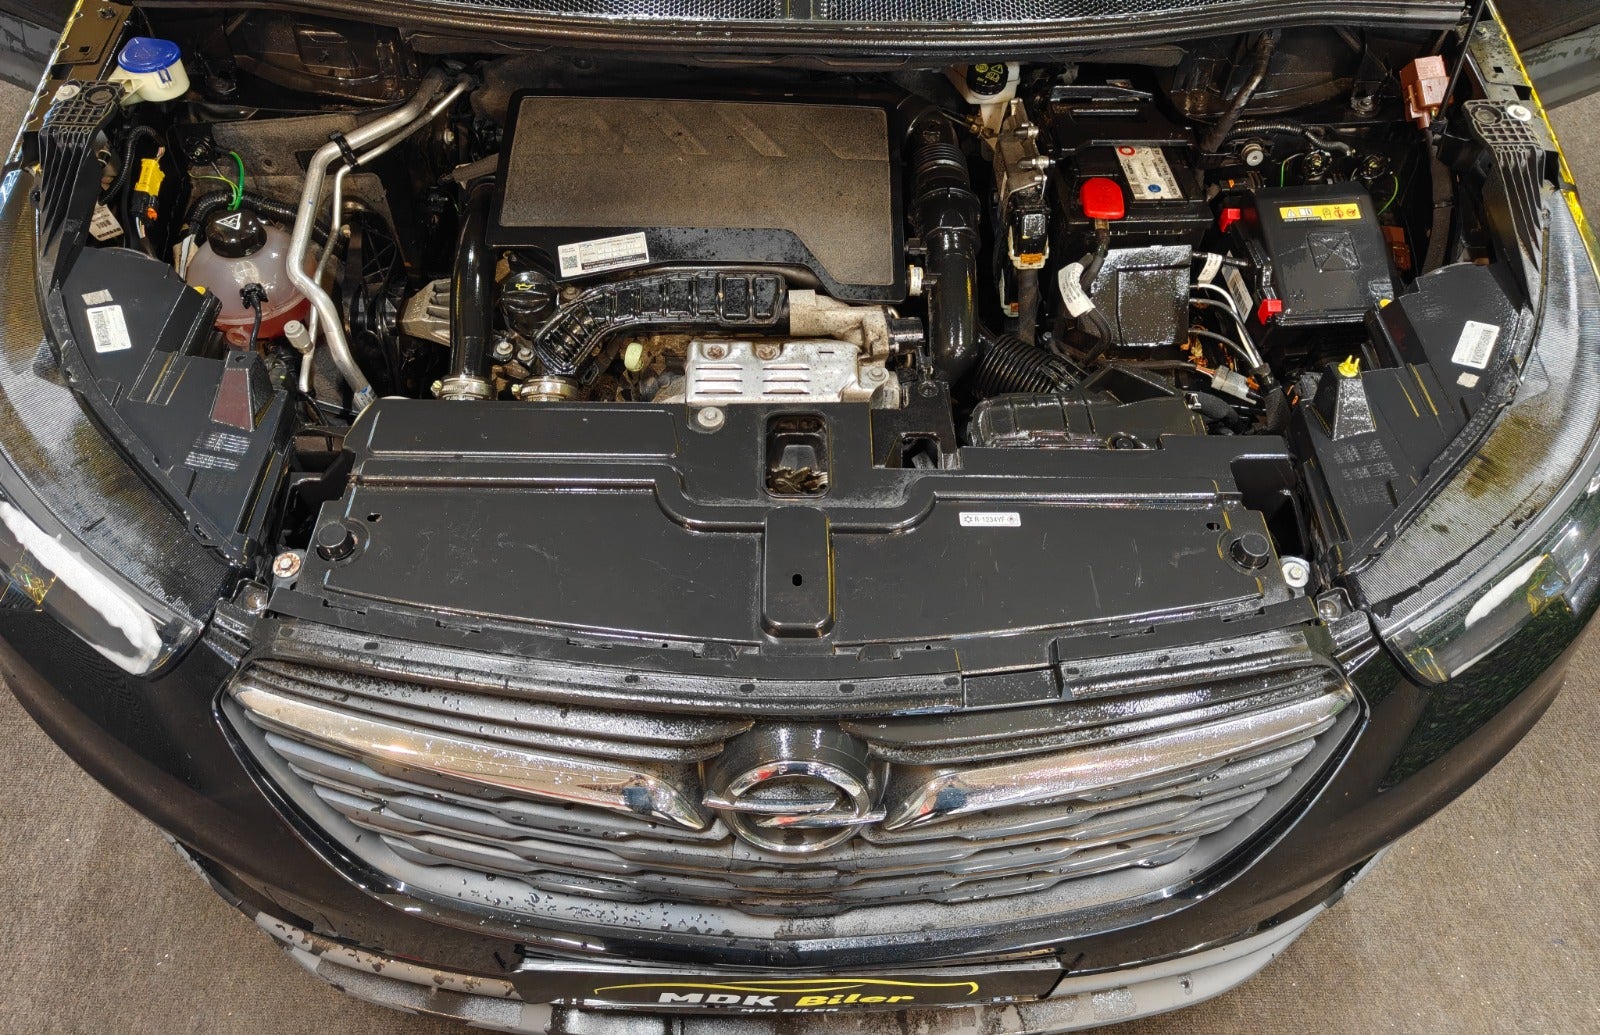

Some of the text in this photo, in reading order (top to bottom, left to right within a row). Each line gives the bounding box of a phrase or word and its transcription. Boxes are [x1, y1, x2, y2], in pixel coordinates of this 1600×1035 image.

[974, 515, 1005, 523] R-1234YF
[658, 992, 916, 1007] MDK Biler
